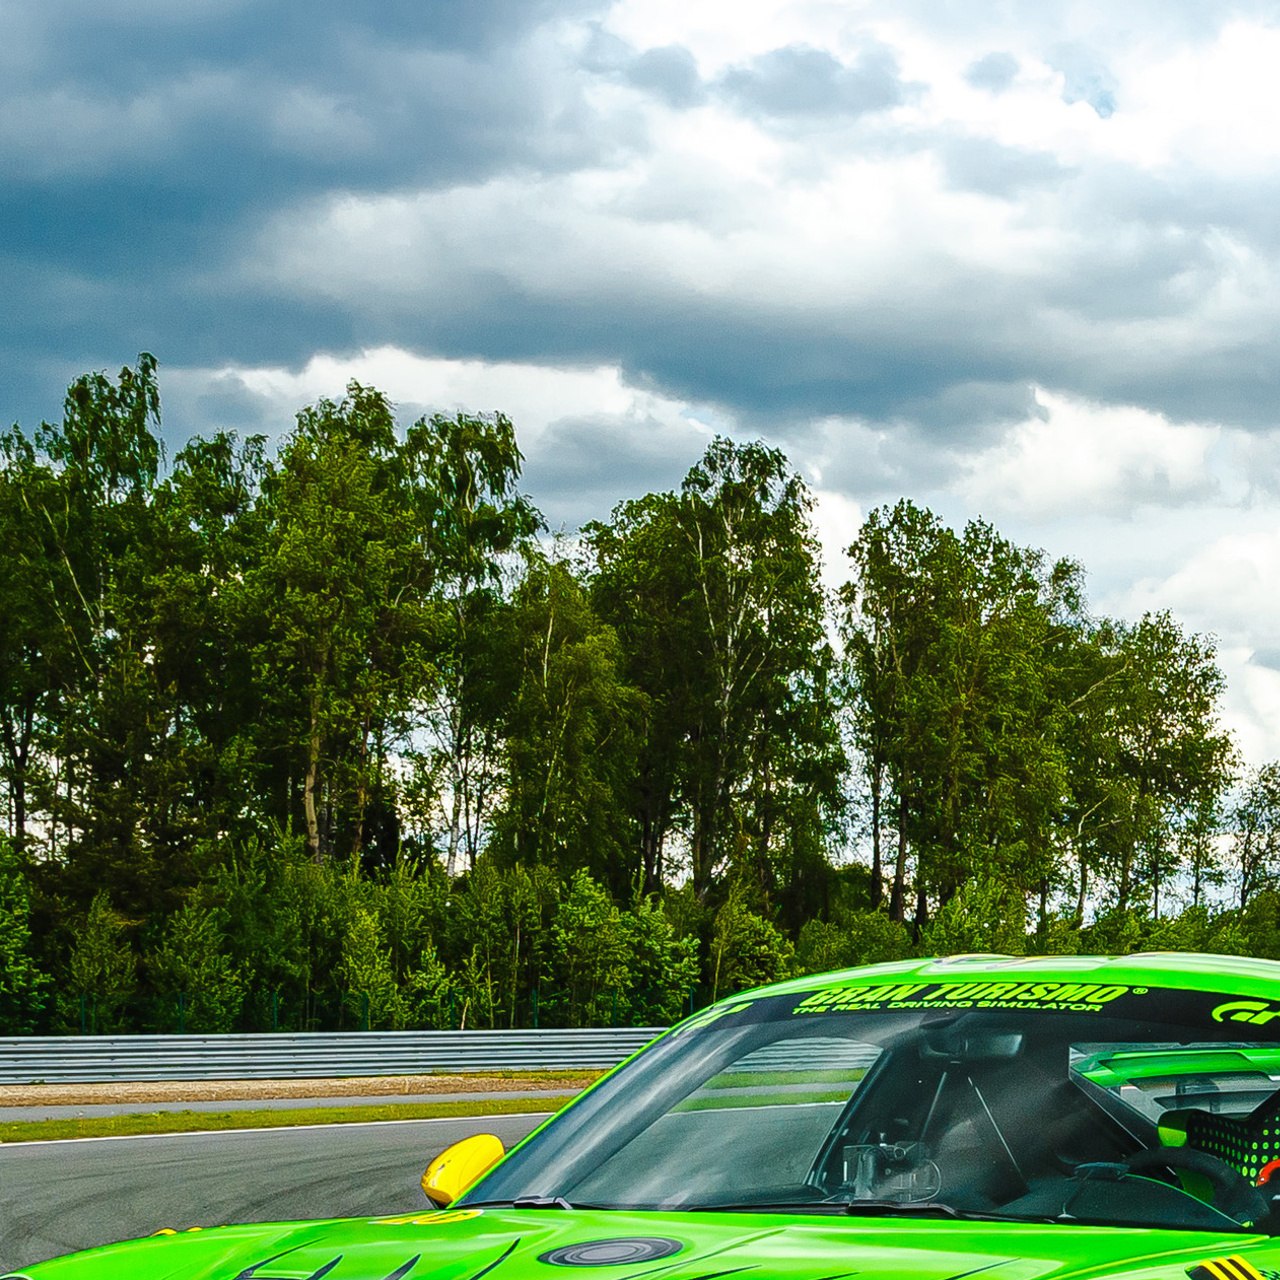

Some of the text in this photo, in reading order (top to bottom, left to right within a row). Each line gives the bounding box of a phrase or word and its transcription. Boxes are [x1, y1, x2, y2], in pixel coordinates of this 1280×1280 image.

[799, 983, 928, 1007] GRAN
[792, 1000, 1104, 1015] THE REAL DRIVING SIMULATOR
